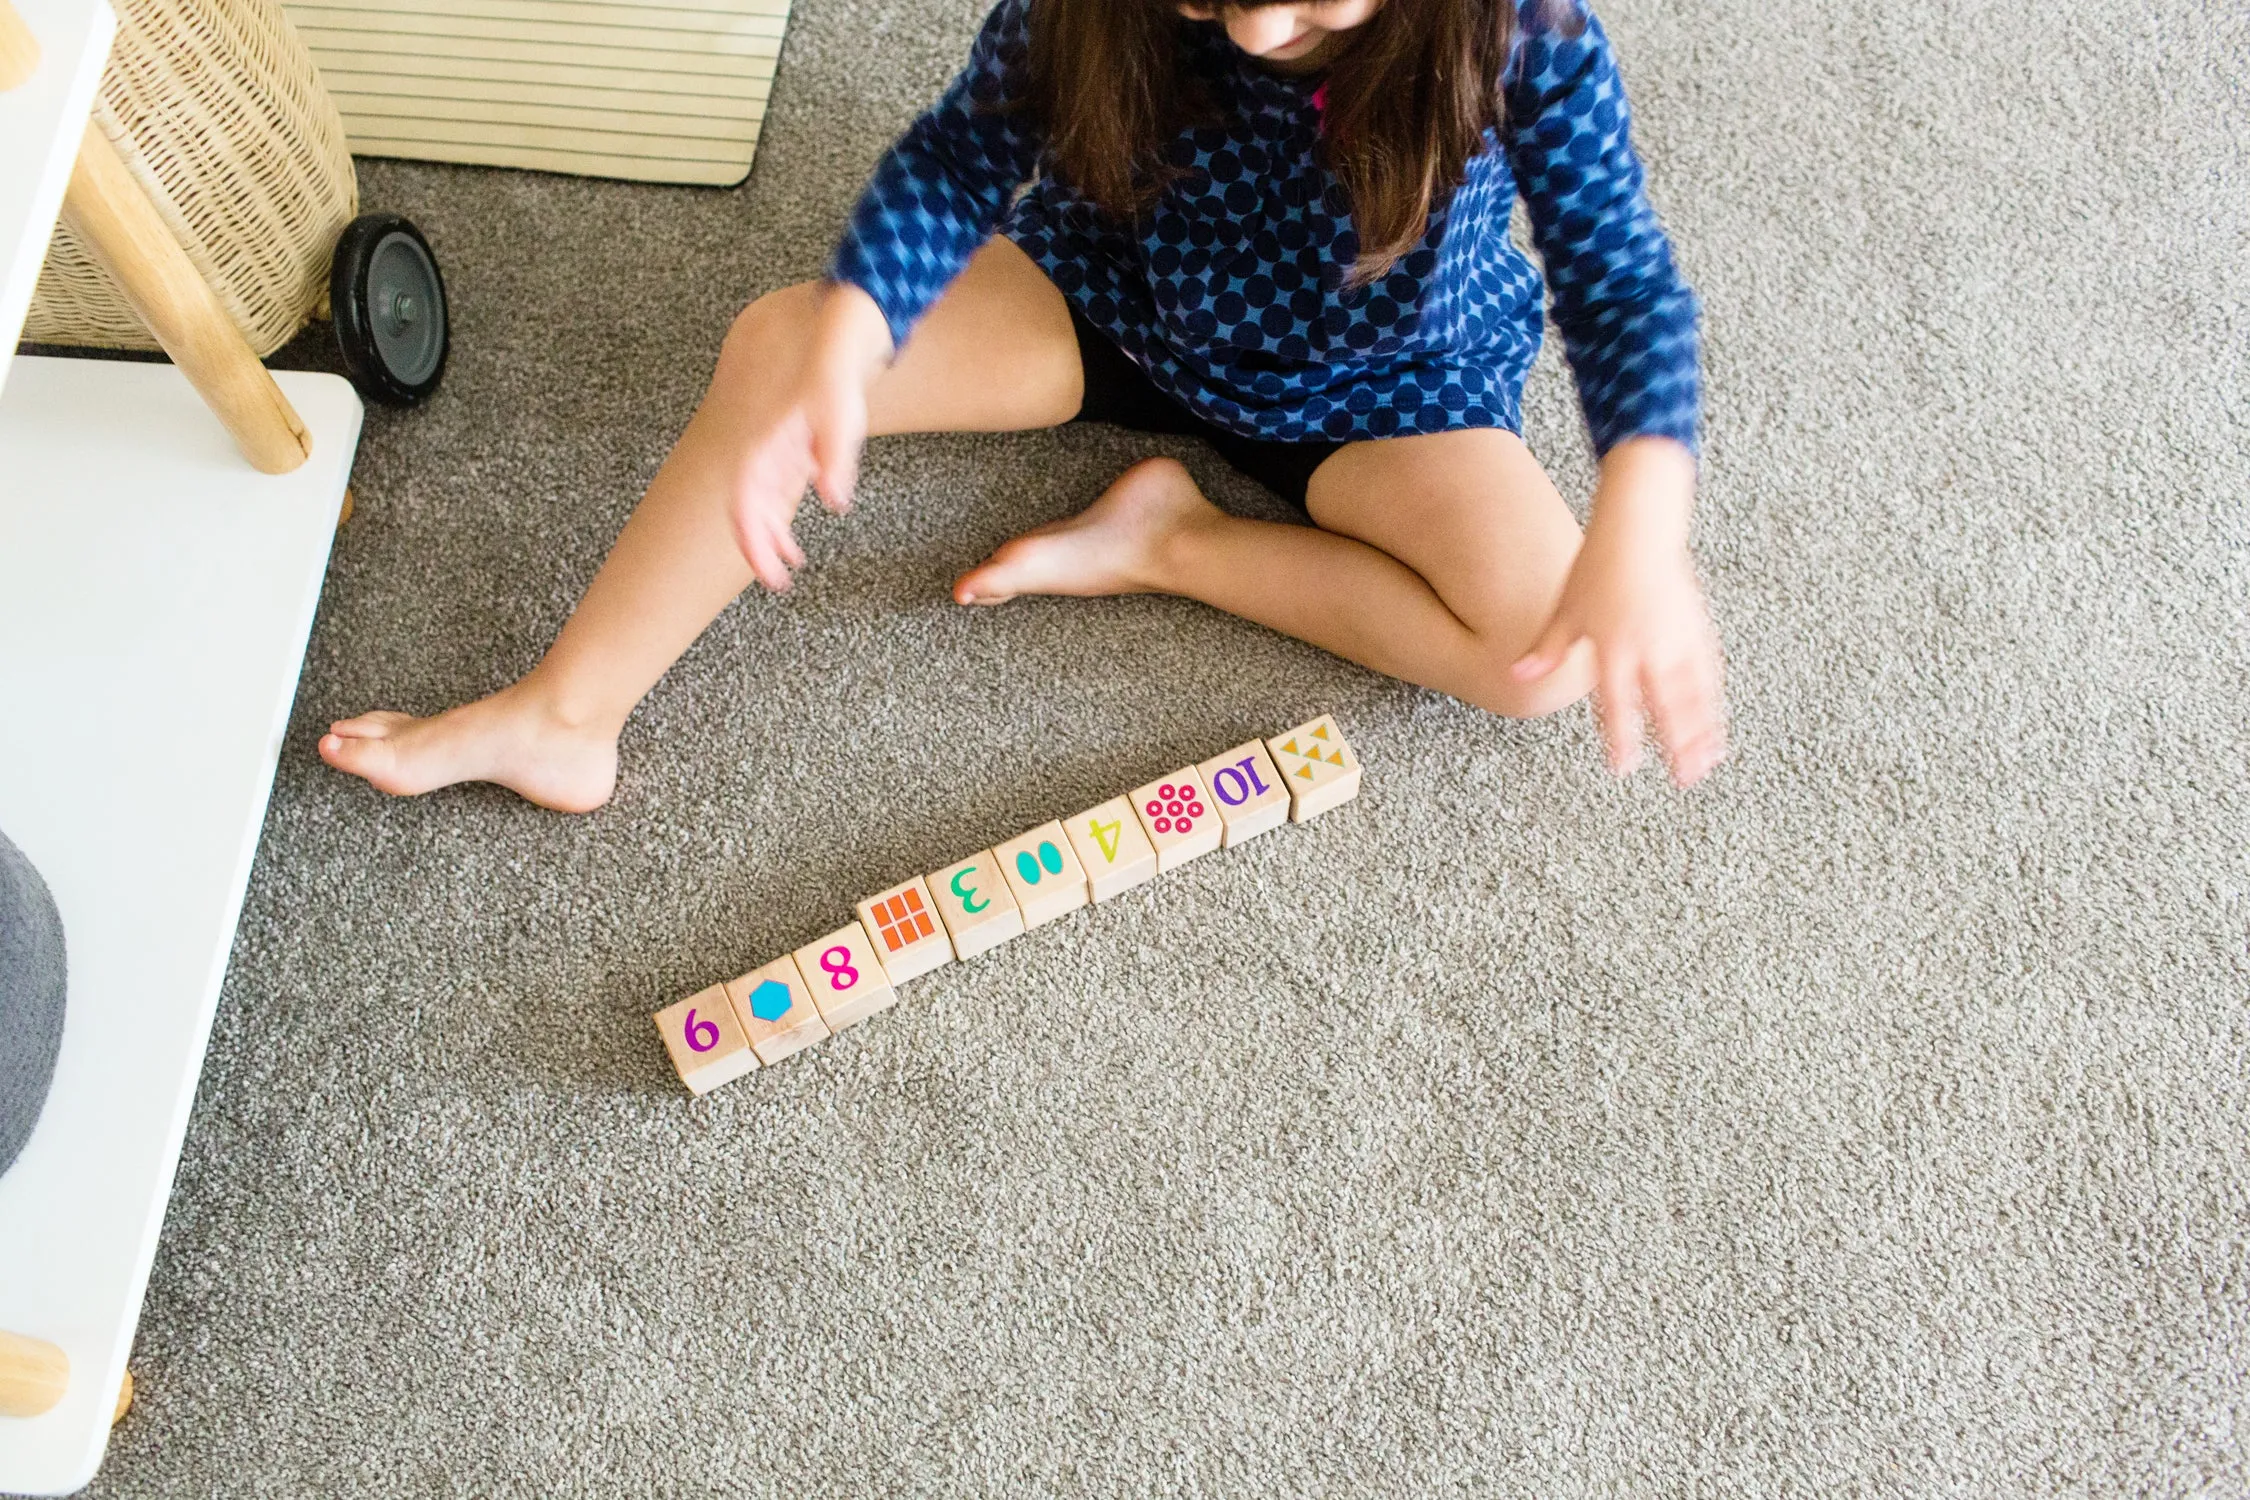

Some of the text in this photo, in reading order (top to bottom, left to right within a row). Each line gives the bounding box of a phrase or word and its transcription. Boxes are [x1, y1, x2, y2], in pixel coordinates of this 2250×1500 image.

[1213, 756, 1270, 806] 10
[1089, 819, 1121, 863] 4
[950, 867, 990, 914] 3
[819, 945, 859, 991] 8
